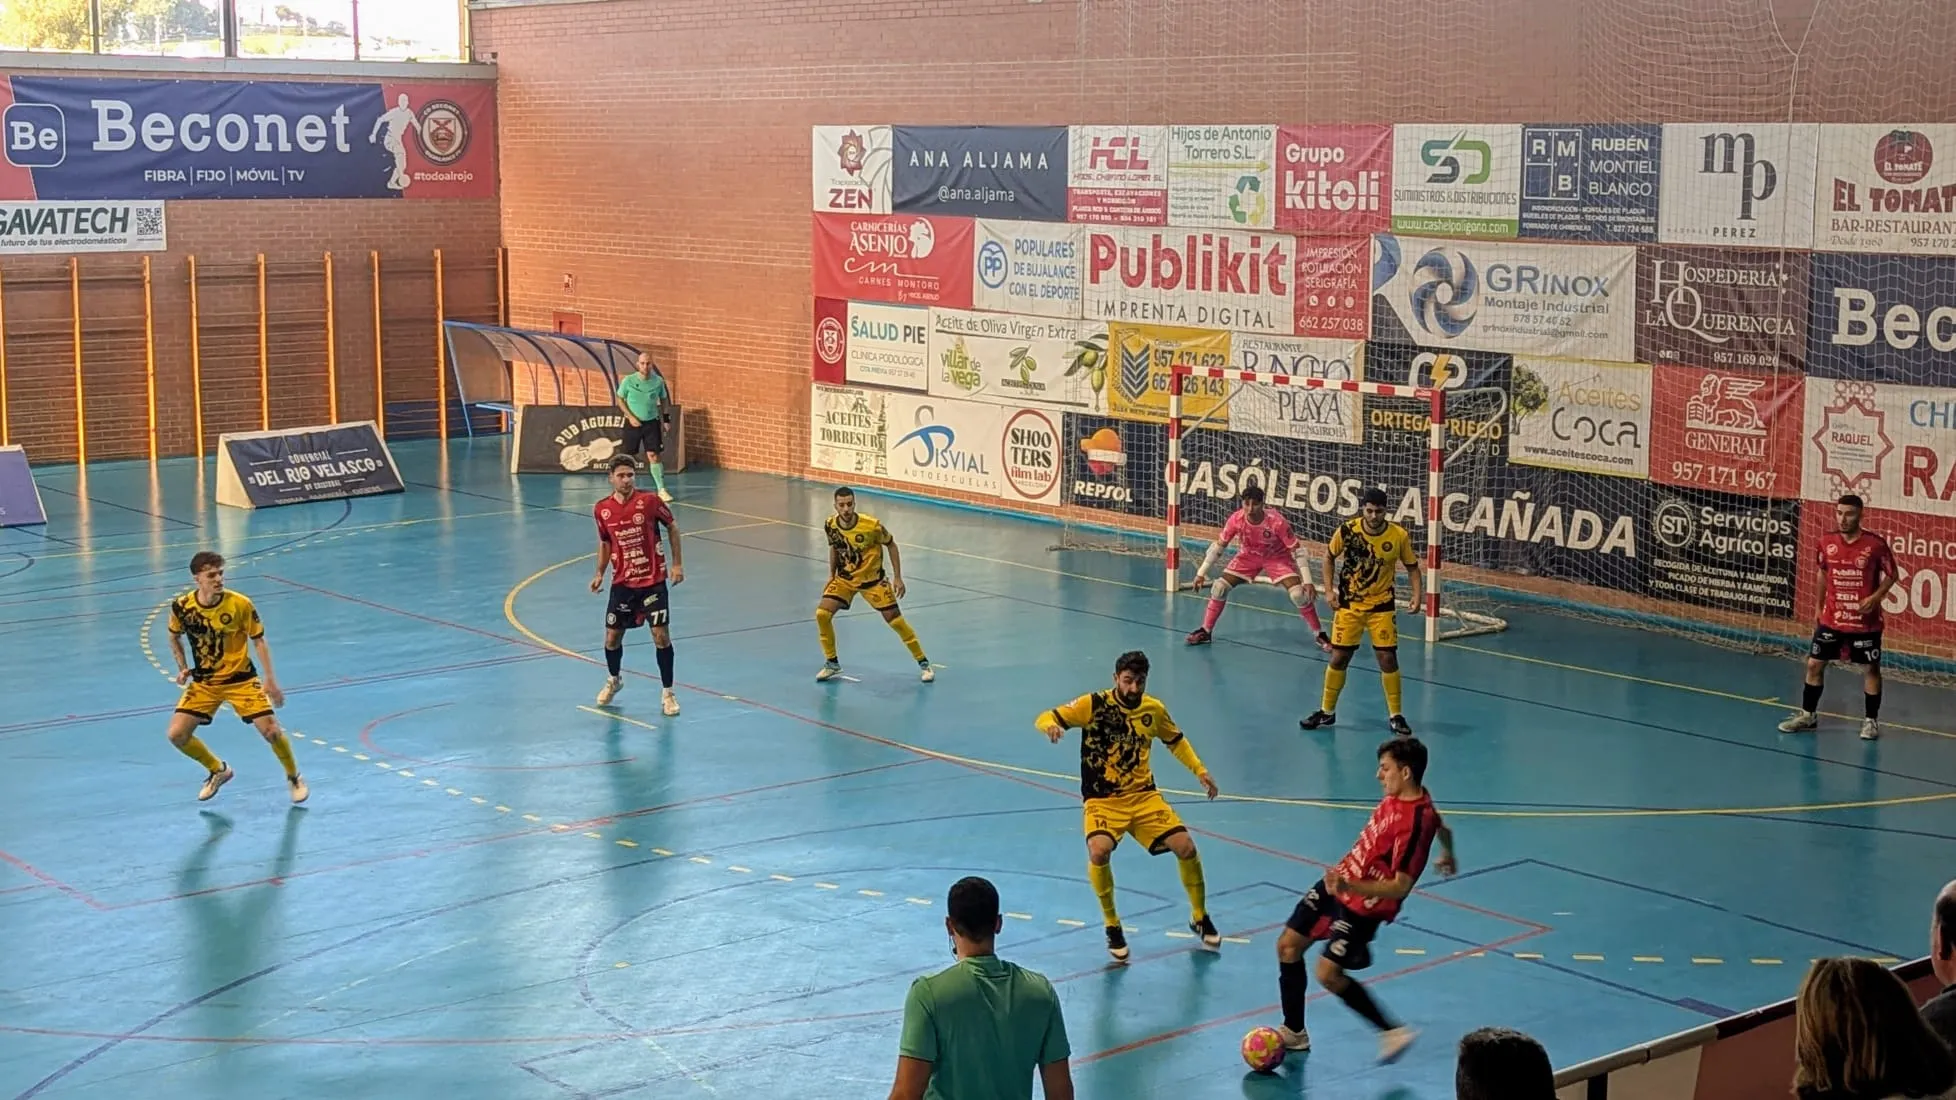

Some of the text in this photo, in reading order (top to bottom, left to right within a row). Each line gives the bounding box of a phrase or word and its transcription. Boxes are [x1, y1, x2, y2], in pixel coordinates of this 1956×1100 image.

[10, 121, 58, 151] Be
[90, 99, 351, 153] Beconet
[1171, 126, 1272, 144] Hijos de Antonio
[1184, 145, 1256, 160] Torrero S.L.
[1532, 139, 1546, 156] R
[1557, 140, 1576, 157] M
[1591, 135, 1649, 152] RUBÉN
[909, 150, 1049, 170] ANA ALJAMA
[1285, 143, 1345, 168] Grupo
[145, 167, 305, 183] FIBRA FIJO MÓVIL TV
[413, 170, 474, 183] #todoalrojo
[1589, 159, 1657, 175] MONTIEL
[1285, 169, 1380, 212] kitoli
[1558, 174, 1572, 192] B
[1588, 181, 1653, 197] BLANCO
[828, 188, 873, 209] ZEN
[938, 185, 1015, 205] @ana.aljama
[1393, 189, 1446, 203] SUMINISTROS
[1453, 191, 1517, 206] DISTRIBUCIONES
[1833, 177, 1861, 212] EL
[850, 220, 908, 234] CARNICERÍAS
[1712, 226, 1757, 238] PEREZ
[27, 238, 38, 247] de
[39, 238, 53, 247] tus
[54, 236, 128, 247] electrodomésticos
[849, 231, 908, 258] ASENJO
[1014, 238, 1076, 259] POPULARES
[1910, 237, 1949, 249] 957 170
[1305, 246, 1358, 259] IMPRESIÓN
[1013, 261, 1077, 280] DE BUJALANCE
[1089, 232, 1287, 296] Publikit
[1301, 260, 1362, 274] ROTULACIÓN
[858, 276, 940, 291] CARNES MONTORO
[1008, 281, 1081, 301] CON EL DEPORTE
[1304, 276, 1358, 290] SERIGRAFÍA
[1096, 298, 1276, 330] IMPRENTA DIGITAL
[1484, 296, 1609, 315] Montaje Industrial
[1645, 286, 1797, 343] LA QUERENCIA
[850, 315, 899, 341] SALUD
[902, 325, 926, 345] PIE
[980, 319, 1007, 335] Oliva
[1048, 324, 1078, 341] Extra
[1299, 316, 1364, 332] 662 257 038
[1832, 287, 1956, 353] Bec
[1242, 339, 1303, 354] RESTAURANTE
[940, 348, 982, 373] villar de
[1153, 349, 1198, 368] 957 171
[1713, 351, 1757, 365] 957 169
[941, 370, 950, 383] la
[950, 369, 981, 392] vega
[1201, 377, 1225, 397] 143
[1560, 381, 1641, 412] Aceites
[1276, 390, 1345, 427] PLAYA
[825, 410, 872, 429] ACEITES
[1370, 408, 1432, 432] ORTEGA
[554, 423, 580, 446] PUB
[1010, 427, 1053, 449] SHOO
[1684, 431, 1768, 458] GENERALI
[1830, 431, 1874, 447] RAQUEL
[1010, 446, 1053, 469] TERS
[1523, 445, 1634, 466] www.aceitescoca.com
[253, 470, 285, 487] DEL
[312, 457, 377, 478] VELASCO
[903, 468, 998, 489] AUTOESCUELAS
[1010, 466, 1053, 483] film lab
[1672, 460, 1778, 491] 957 171 967
[1074, 480, 1134, 503] REPSOL
[1441, 488, 1637, 560] CAÑADA
[1660, 513, 1688, 537] ST
[1700, 506, 1792, 536] Servicios
[1698, 528, 1795, 559] Agrícolas
[1653, 559, 1789, 586] RECOGIDA DE ACEITUNA Y ALMENDRA
[1667, 572, 1697, 584] PICADO
[1697, 576, 1709, 586] DE
[1708, 577, 1736, 590] HIERBA
[1655, 581, 1675, 591] TODA
[1675, 583, 1699, 595] CLASE
[1699, 586, 1709, 596] DE
[1709, 588, 1748, 602] TRABAJOS
[650, 609, 668, 626] 77
[1864, 649, 1880, 662] 10
